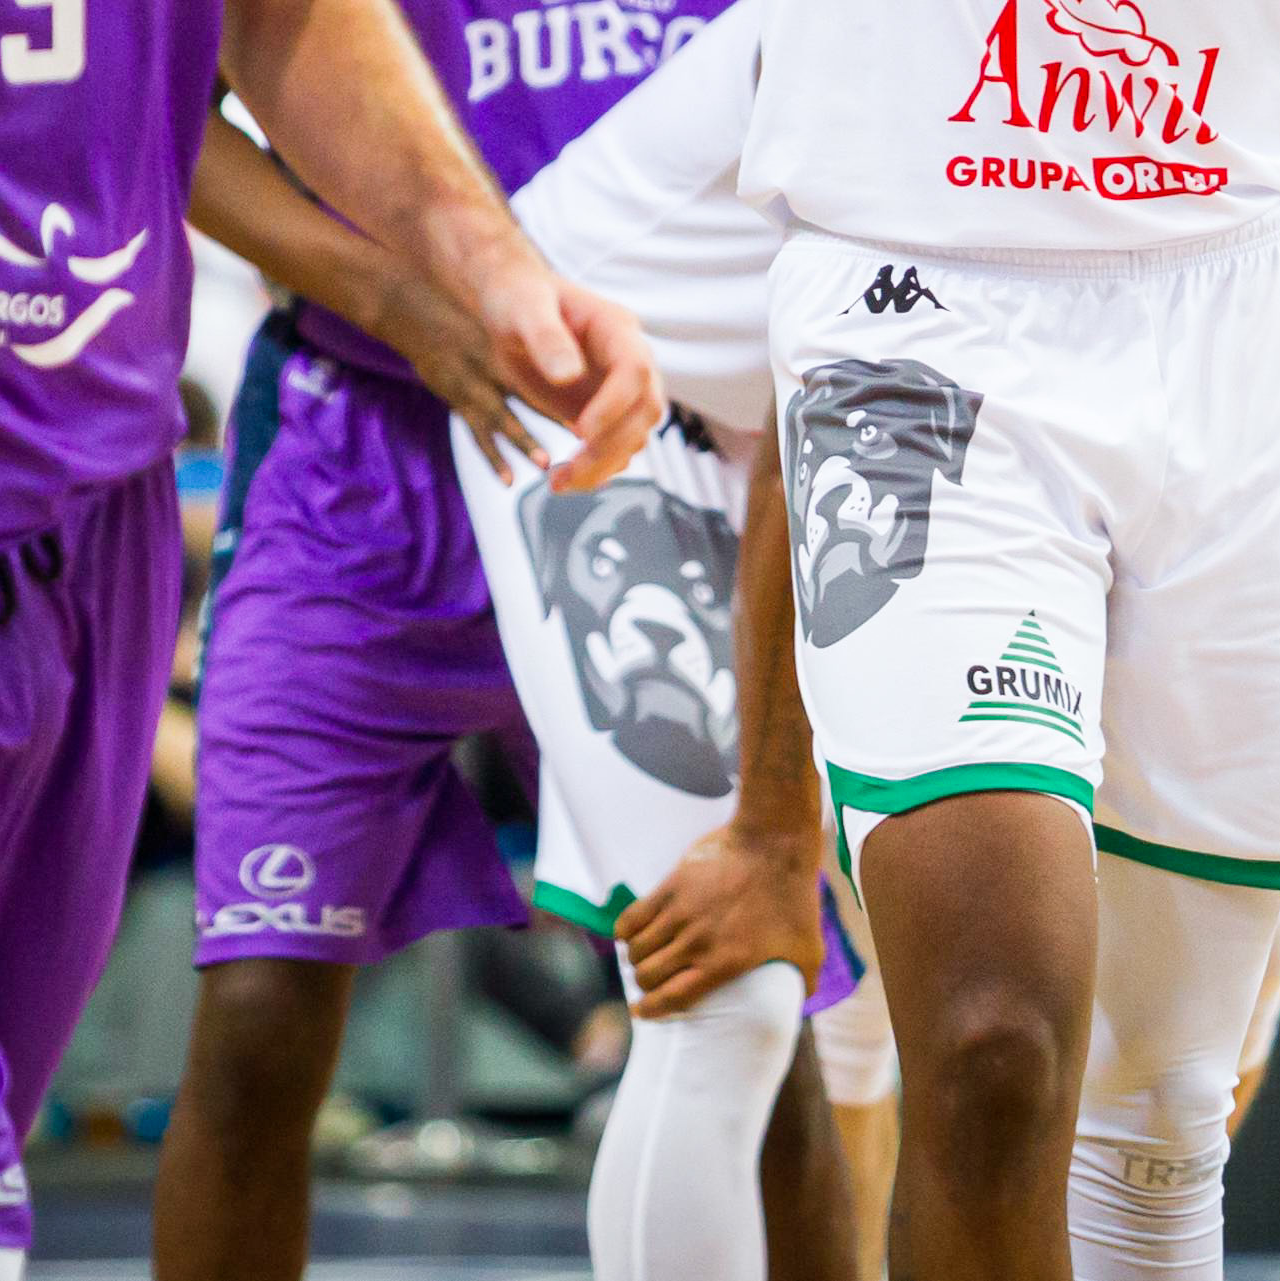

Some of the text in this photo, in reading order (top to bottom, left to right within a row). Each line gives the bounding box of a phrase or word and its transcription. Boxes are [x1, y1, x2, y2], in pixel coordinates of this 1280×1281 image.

[464, 0, 709, 104] BURGO
[945, 155, 1091, 192] GRUPA
[966, 664, 1085, 720] GRUMIX
